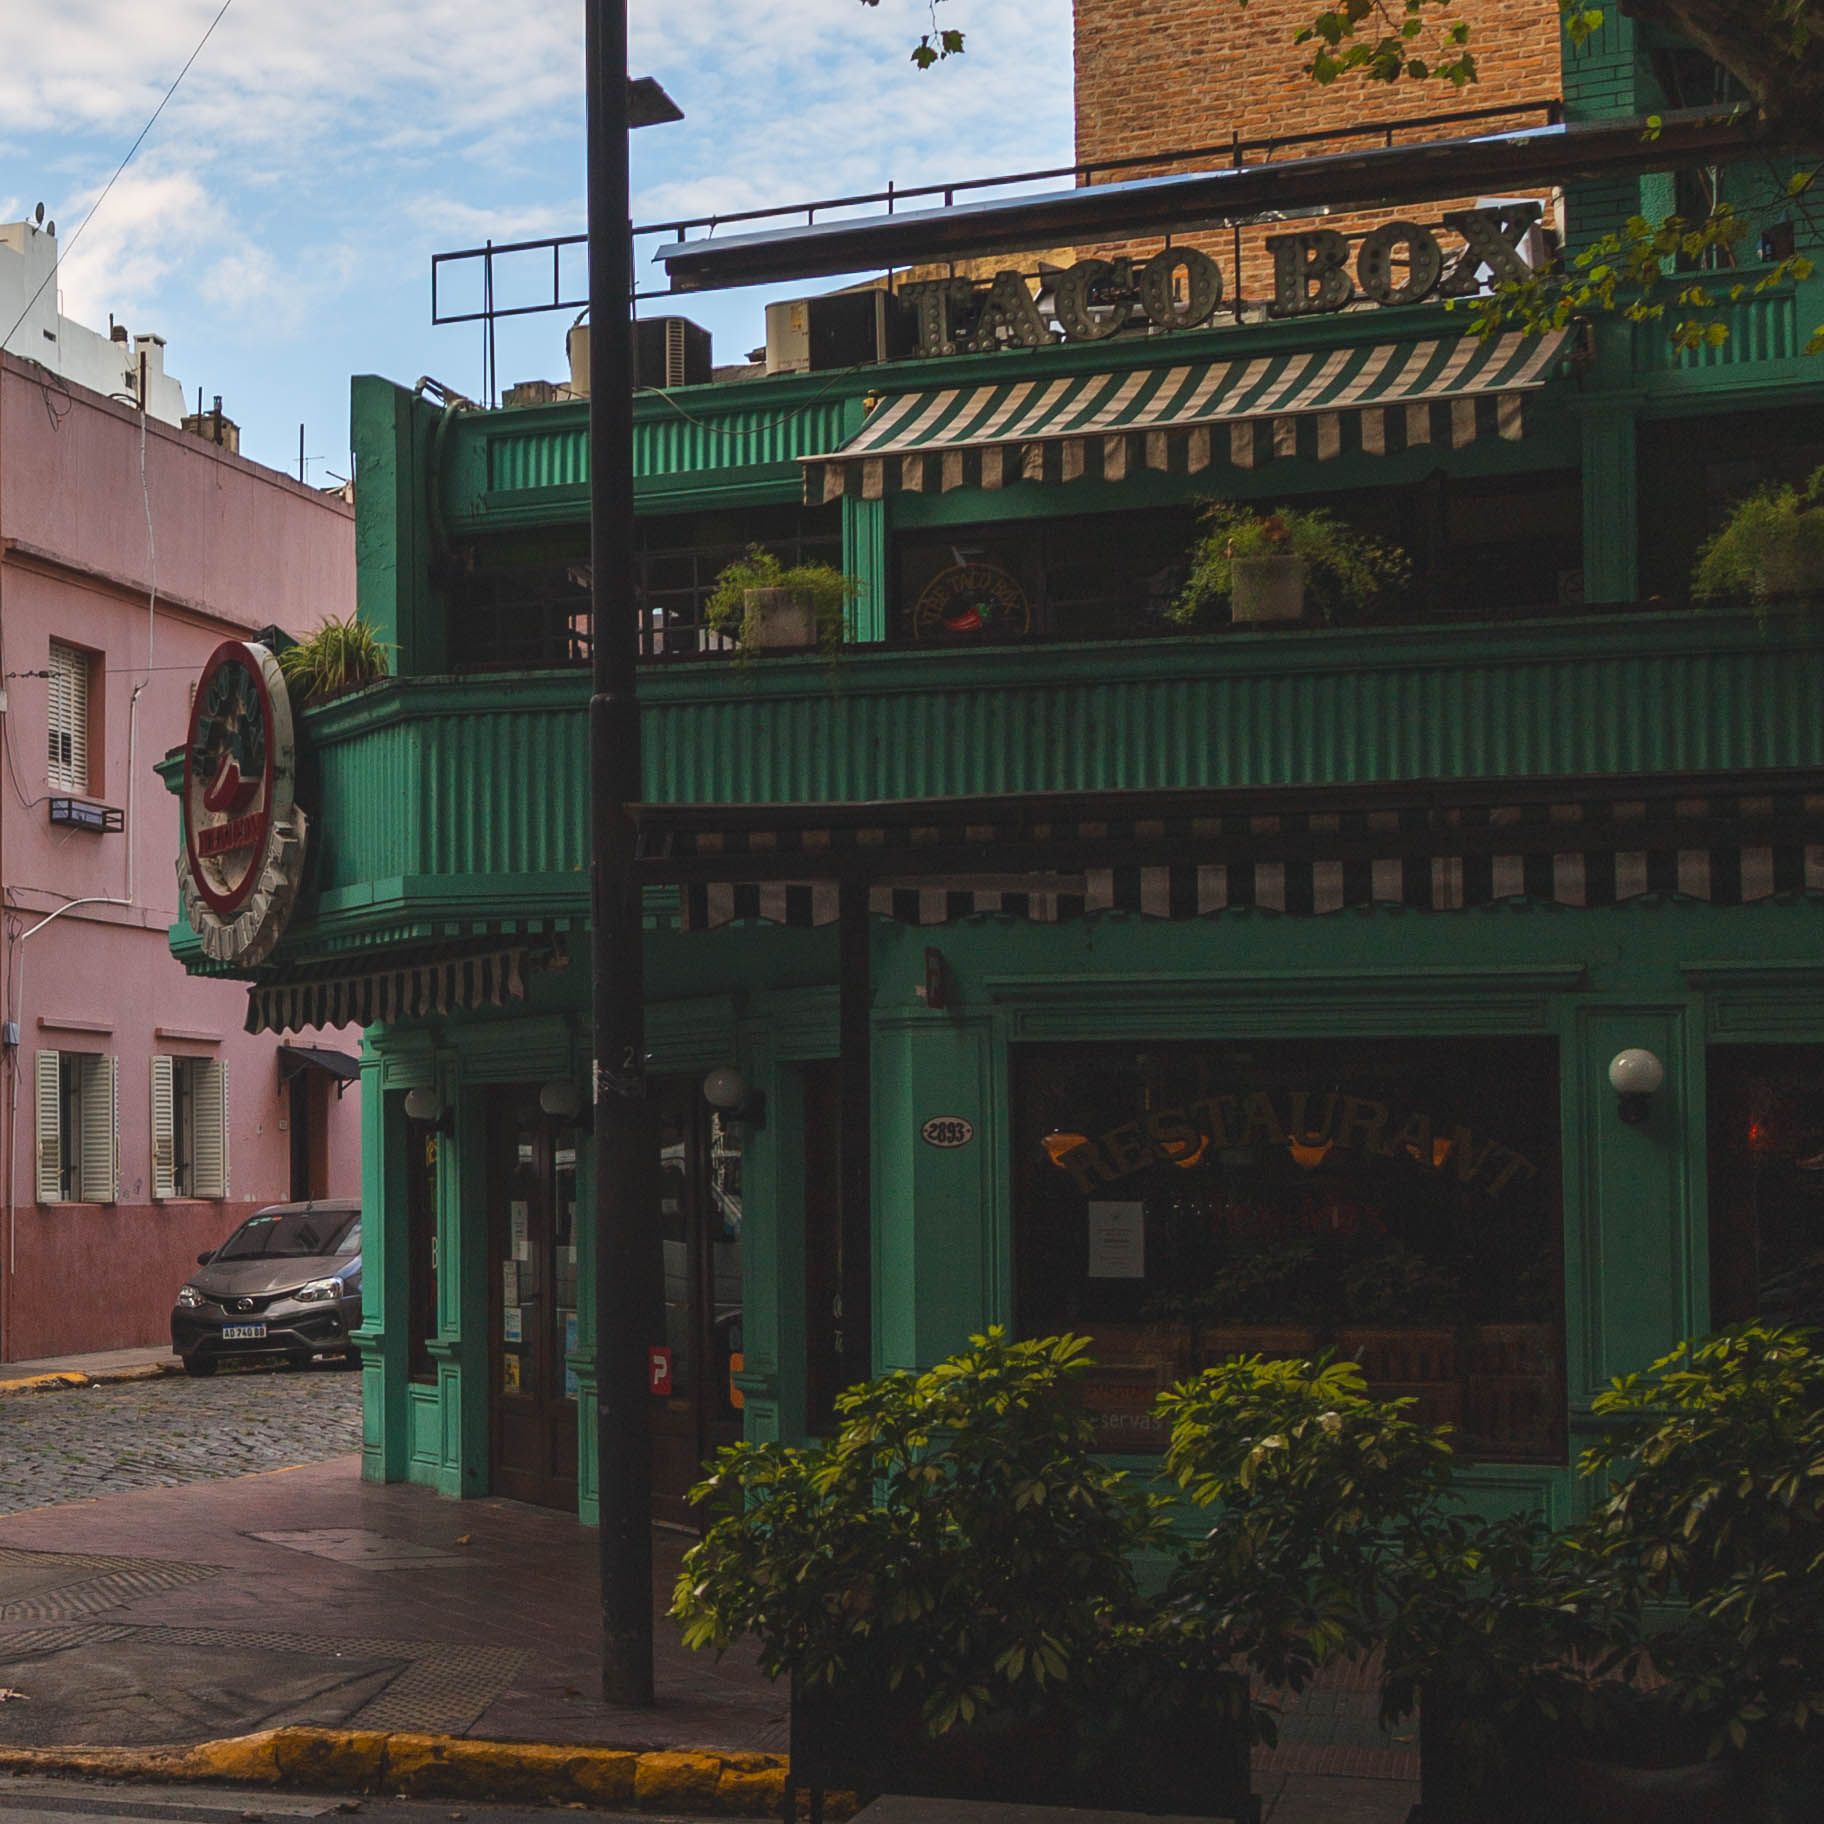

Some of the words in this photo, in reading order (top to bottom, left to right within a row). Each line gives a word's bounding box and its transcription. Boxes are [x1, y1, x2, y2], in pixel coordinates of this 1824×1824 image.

[898, 247, 1223, 356] TACO
[1266, 202, 1543, 317] BOX
[1059, 1089, 1538, 1197] RESTAURANT
